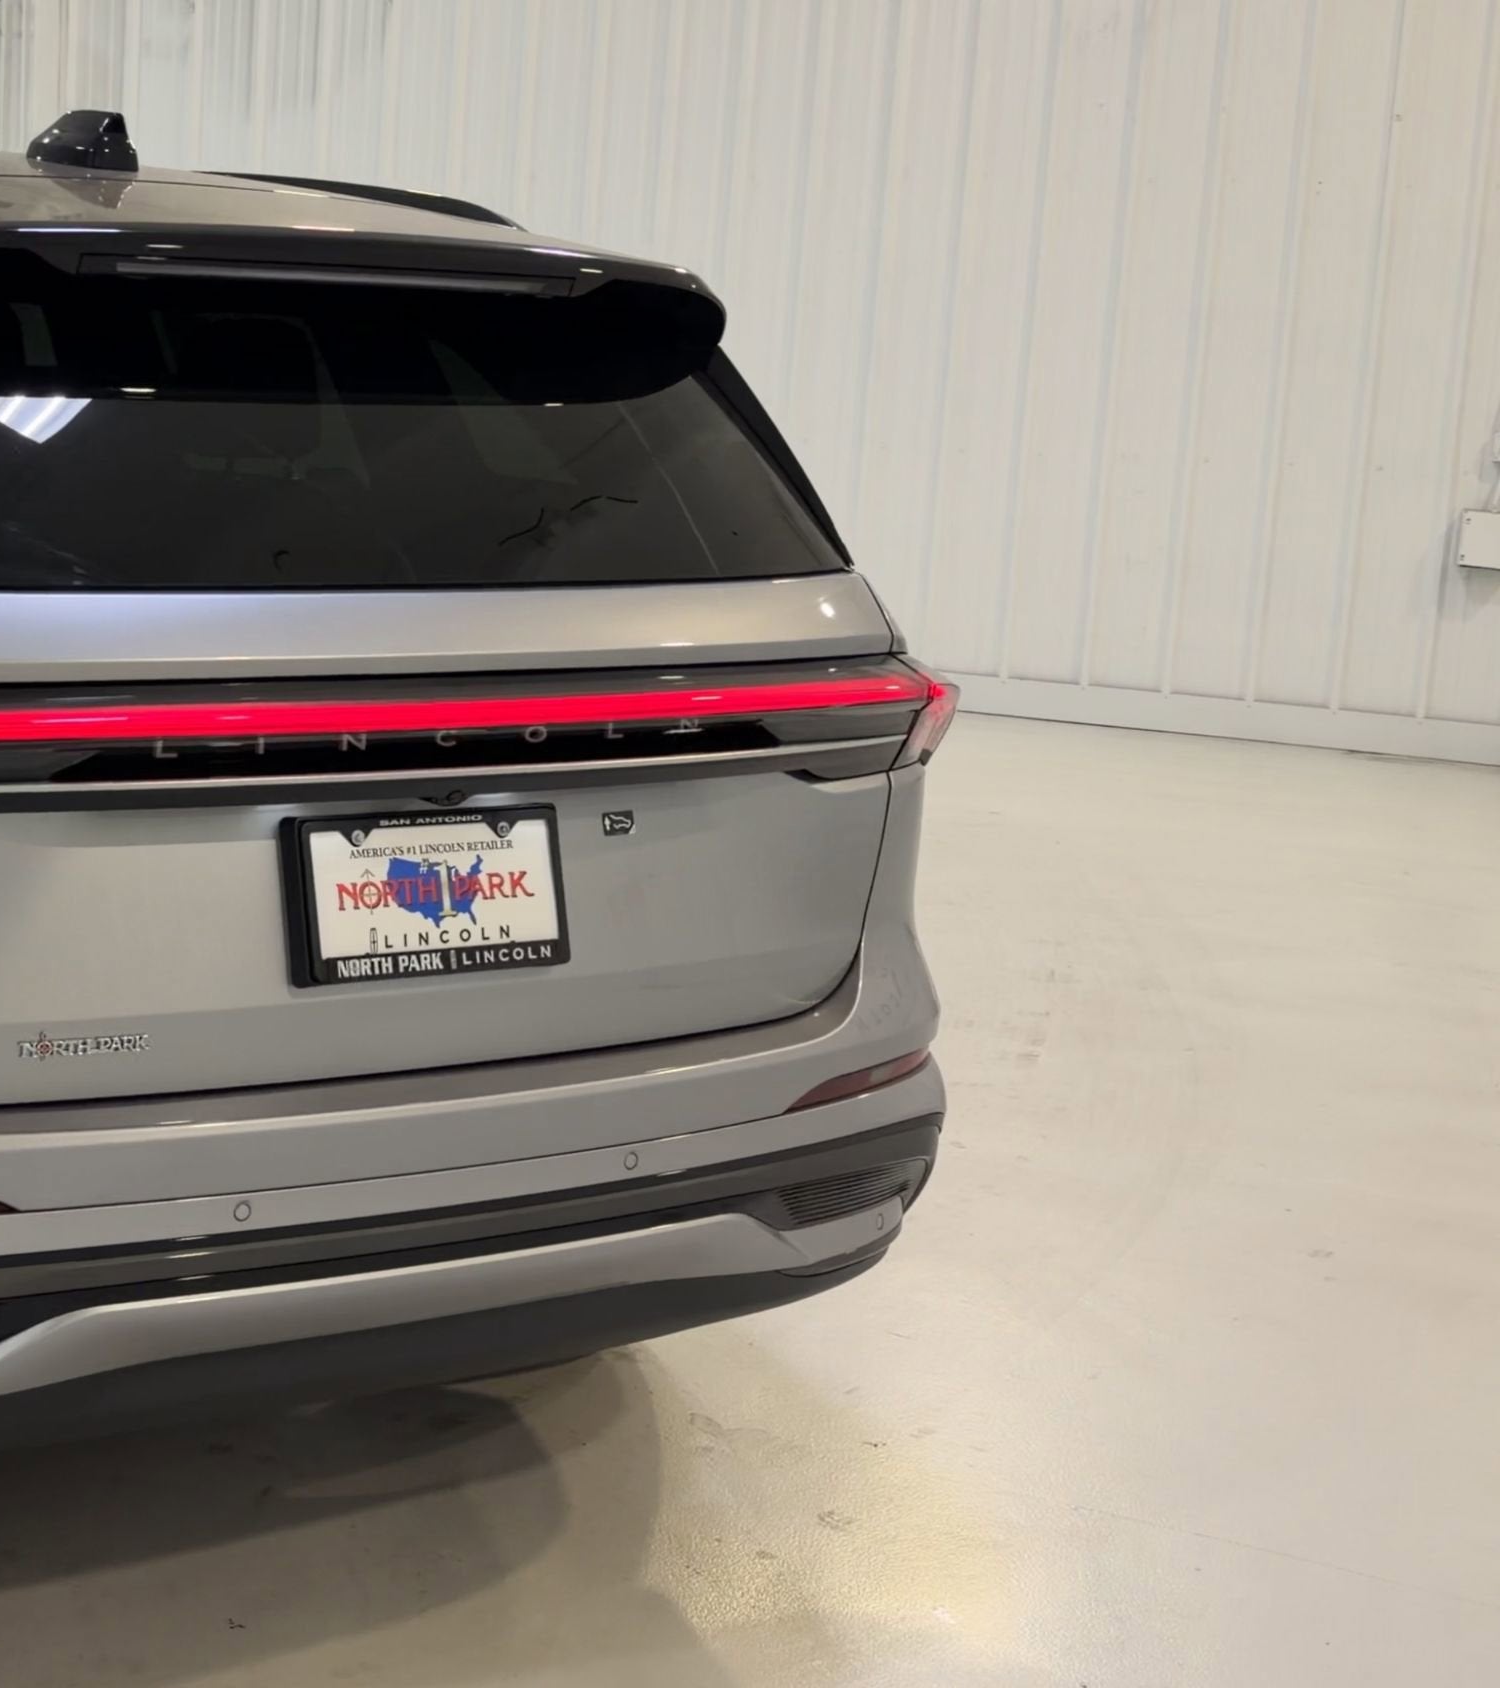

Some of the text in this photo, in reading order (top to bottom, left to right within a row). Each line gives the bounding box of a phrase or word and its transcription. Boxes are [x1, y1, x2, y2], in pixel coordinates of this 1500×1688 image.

[155, 718, 699, 757] LINCOLN
[379, 813, 483, 827] SAN ANTONIO
[349, 845, 405, 860] AMERICA'S
[419, 840, 466, 855] LINCOLN
[467, 839, 514, 852] RETAILER
[336, 871, 535, 911] NORTH PARK
[384, 925, 510, 948] LINCOLN
[337, 945, 552, 979] NORTH PARK LINCOLN
[18, 1034, 149, 1058] NORTH PARK
